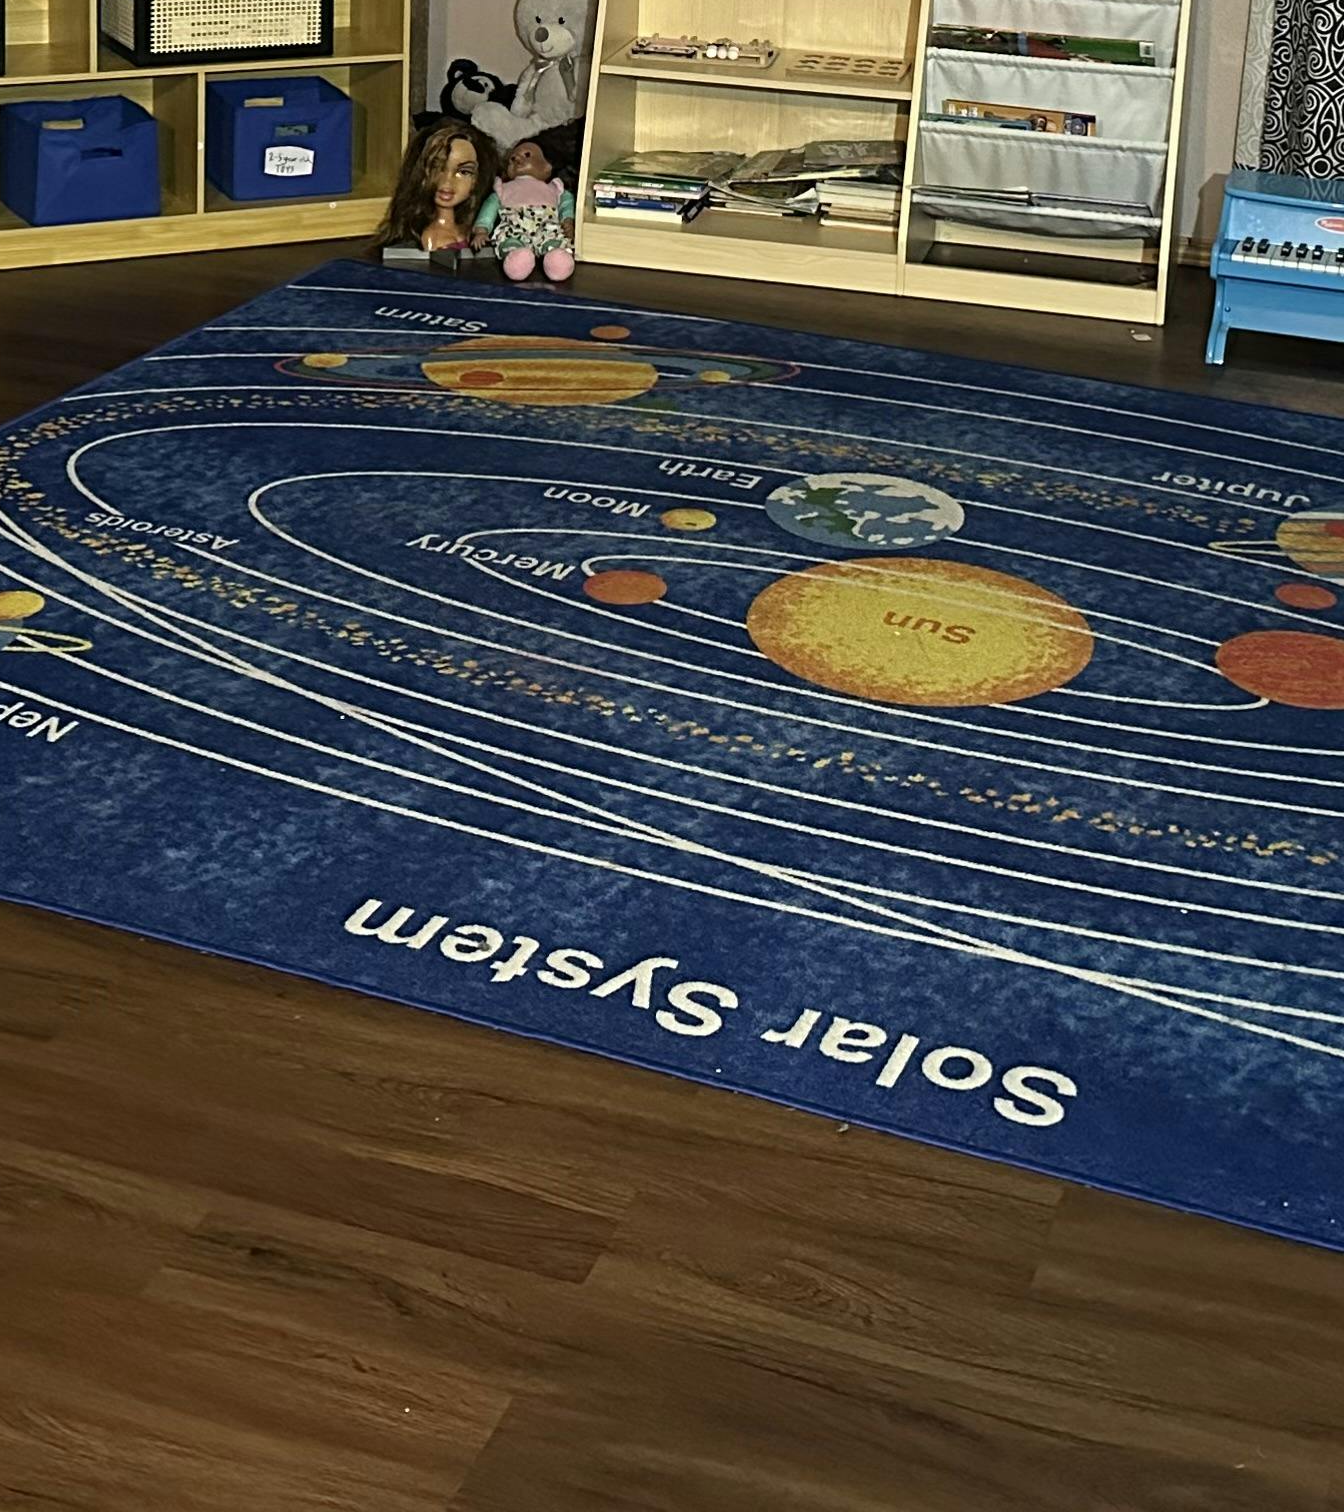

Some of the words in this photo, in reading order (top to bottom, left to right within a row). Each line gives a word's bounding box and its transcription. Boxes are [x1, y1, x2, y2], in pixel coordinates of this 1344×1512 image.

[373, 302, 488, 334] Saturn
[658, 456, 762, 490] Earth
[1151, 469, 1311, 511] Jupiter
[543, 484, 650, 519] Moon
[84, 508, 240, 552] Asteroids
[406, 531, 575, 581] Mercury
[882, 610, 977, 647] Sun
[344, 899, 738, 1038] System
[761, 1008, 1078, 1128] Solar
